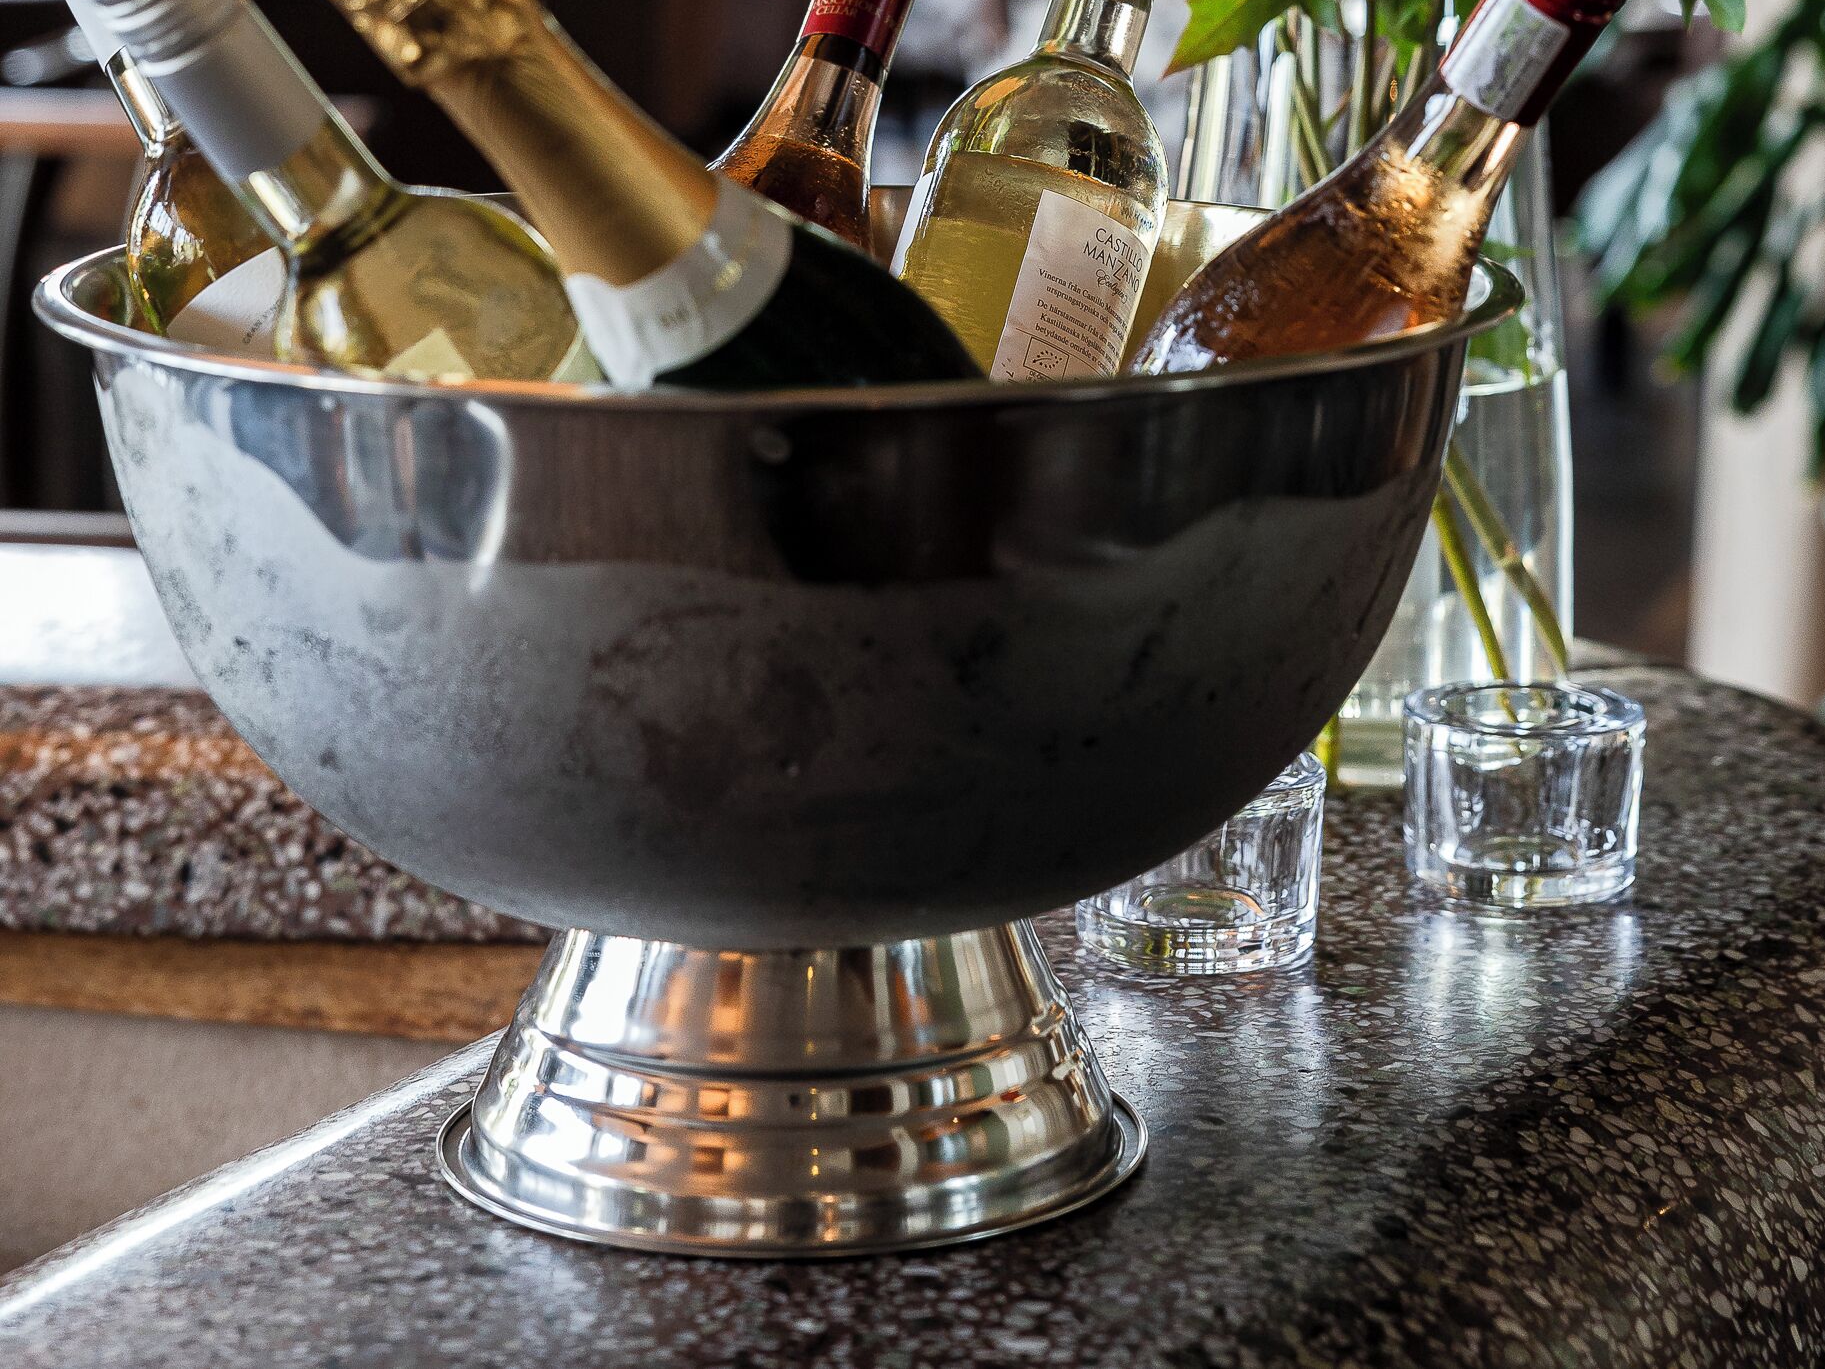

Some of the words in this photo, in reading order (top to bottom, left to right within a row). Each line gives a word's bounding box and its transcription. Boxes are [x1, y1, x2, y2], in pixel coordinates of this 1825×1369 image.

[815, 5, 857, 17] CELLAR
[1083, 241, 1140, 293] MANZANO
[1095, 228, 1143, 272] CASTILLO
[1039, 269, 1067, 286] Vinerna
[1067, 281, 1081, 294] från
[1082, 289, 1105, 308] Castillo
[1046, 285, 1099, 318] ursprungstypiska
[1037, 299, 1048, 310] De
[1049, 304, 1087, 329] härstammar
[1040, 313, 1080, 339] Kastilianska
[1035, 323, 1069, 345] betydande
[1069, 342, 1091, 359] område
